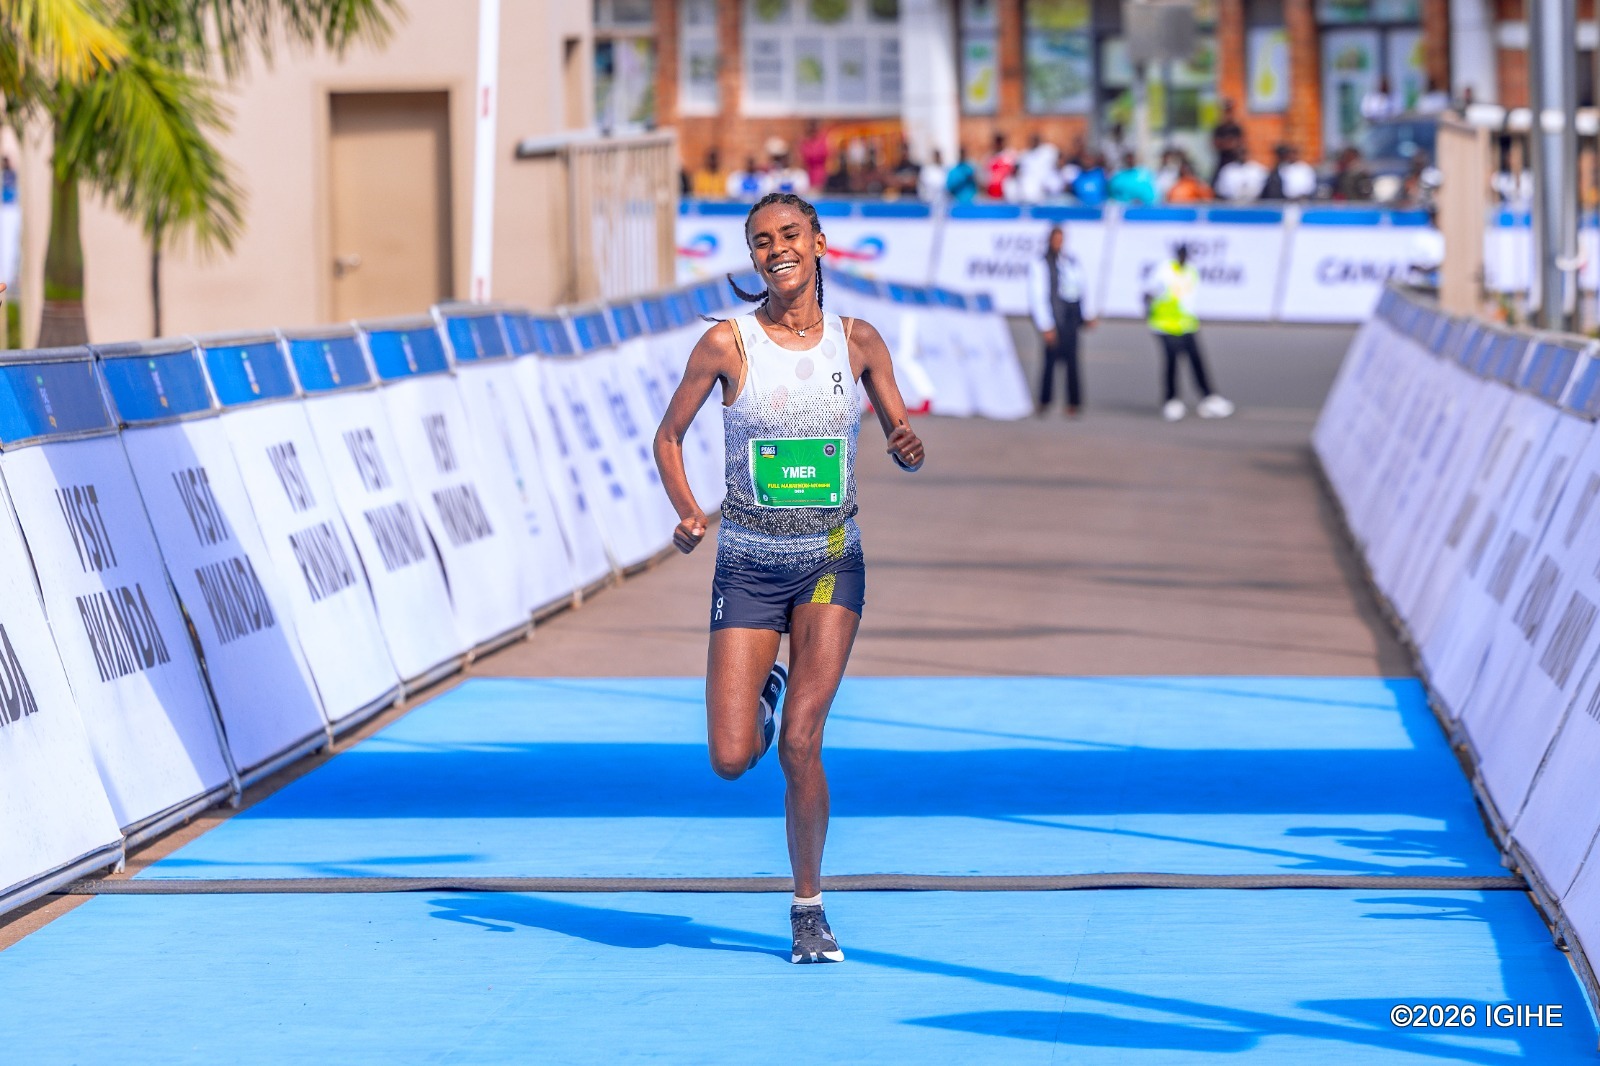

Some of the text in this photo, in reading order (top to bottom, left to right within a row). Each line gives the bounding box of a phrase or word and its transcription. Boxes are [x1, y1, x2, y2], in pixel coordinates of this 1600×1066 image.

[265, 440, 317, 514] VISIT
[342, 426, 392, 494] VISIT
[781, 466, 816, 478] YMER
[54, 484, 118, 573] VISIT
[171, 467, 229, 547] VISIT
[194, 553, 275, 646] RWANDA
[288, 519, 357, 604] RWANDA
[76, 582, 171, 683] RWANDA
